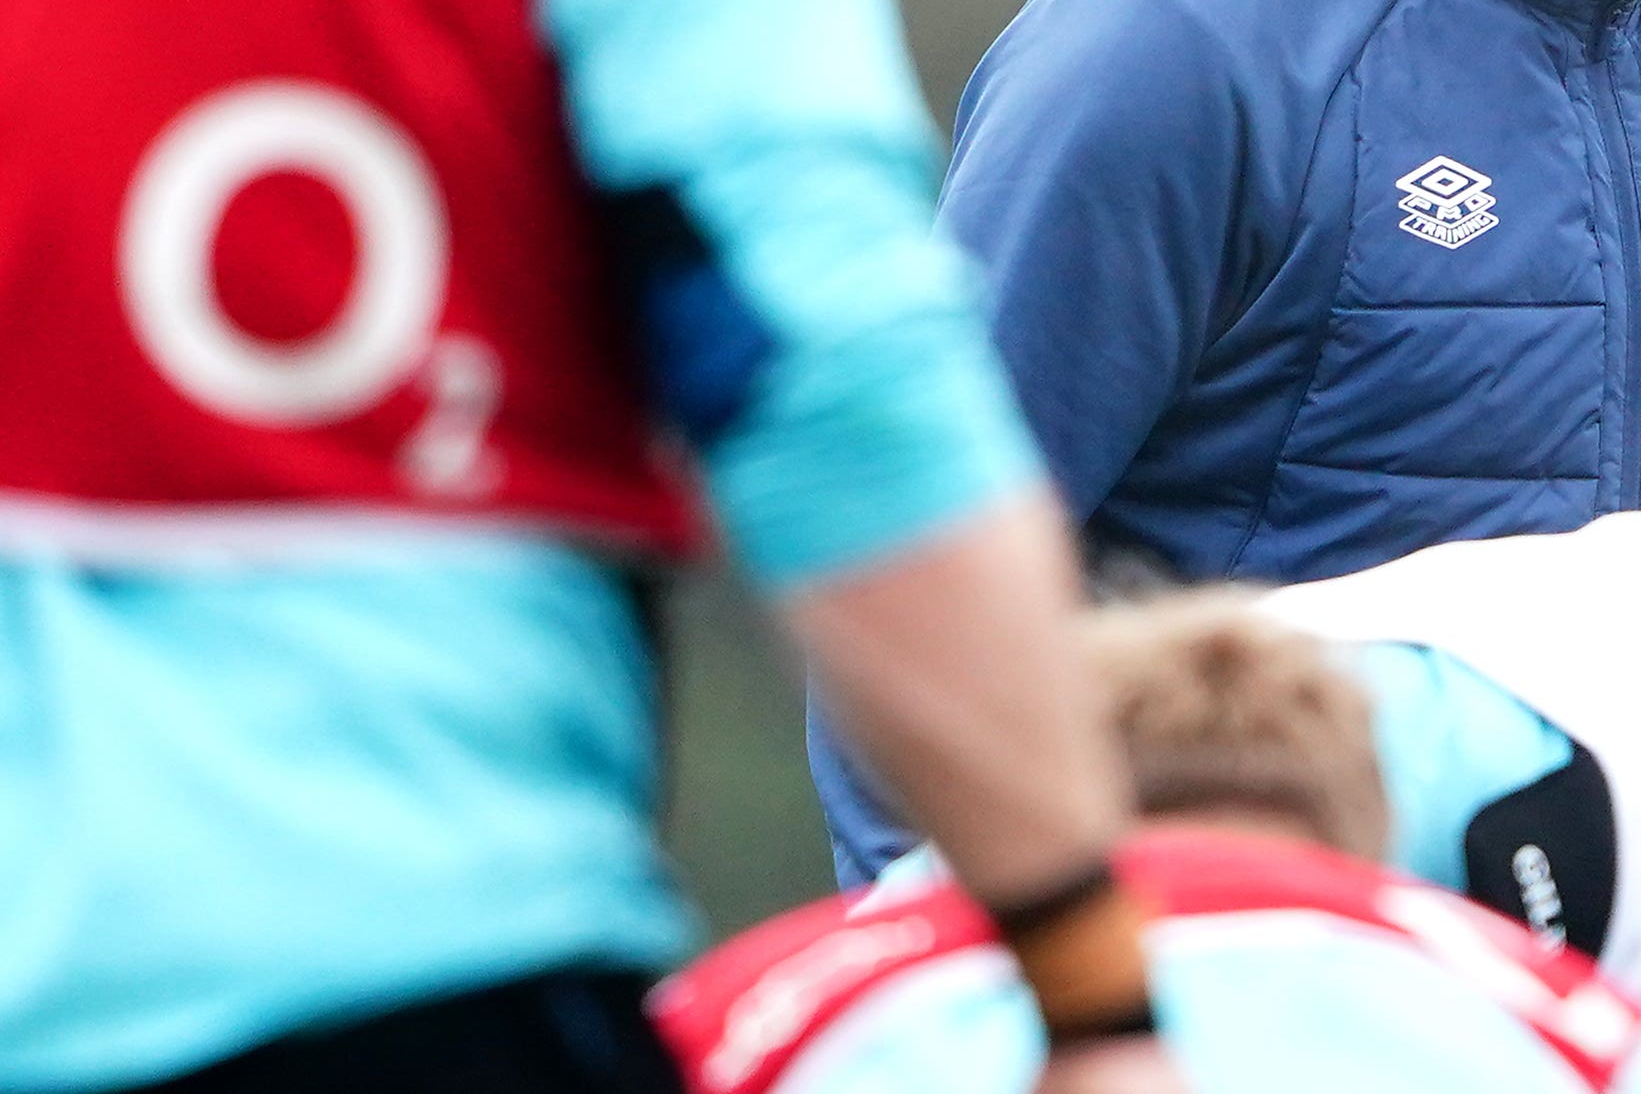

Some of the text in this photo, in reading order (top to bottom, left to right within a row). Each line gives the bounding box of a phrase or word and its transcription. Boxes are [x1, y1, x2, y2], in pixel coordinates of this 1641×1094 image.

[1407, 194, 1489, 220] PRO
[1412, 214, 1491, 244] TRAINING
[113, 76, 507, 499] O2
